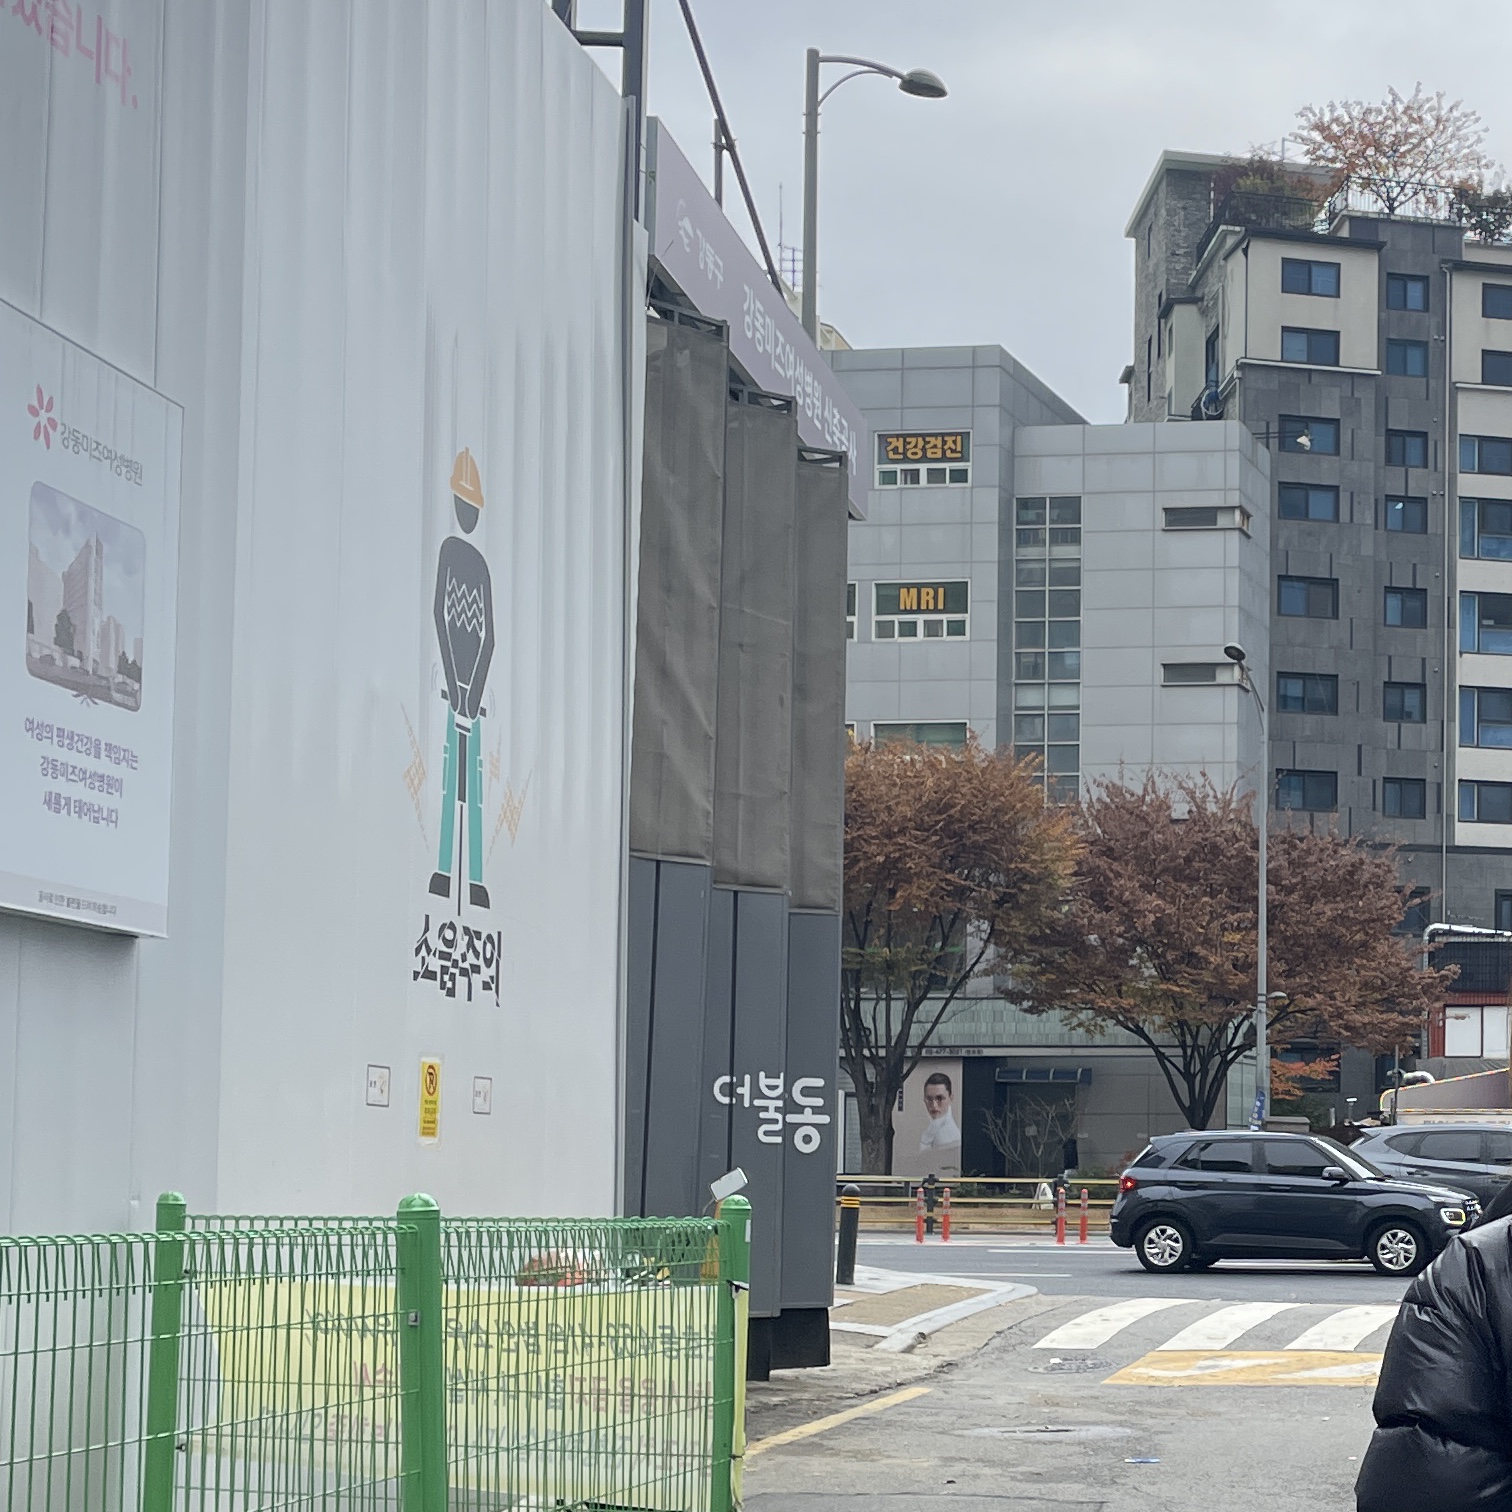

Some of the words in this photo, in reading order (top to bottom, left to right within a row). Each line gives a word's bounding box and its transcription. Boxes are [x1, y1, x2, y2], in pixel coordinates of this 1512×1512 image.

[743, 283, 822, 430] 강동미즈여성병원
[60, 422, 143, 487] 강동미즈여성병원
[886, 435, 963, 460] 건강검진
[899, 587, 945, 611] MRI
[24, 717, 54, 745] 여성의
[39, 755, 124, 799] 강동미즈여성병원이
[73, 798, 119, 829] 태어납니다
[412, 914, 502, 1008] 소음주의
